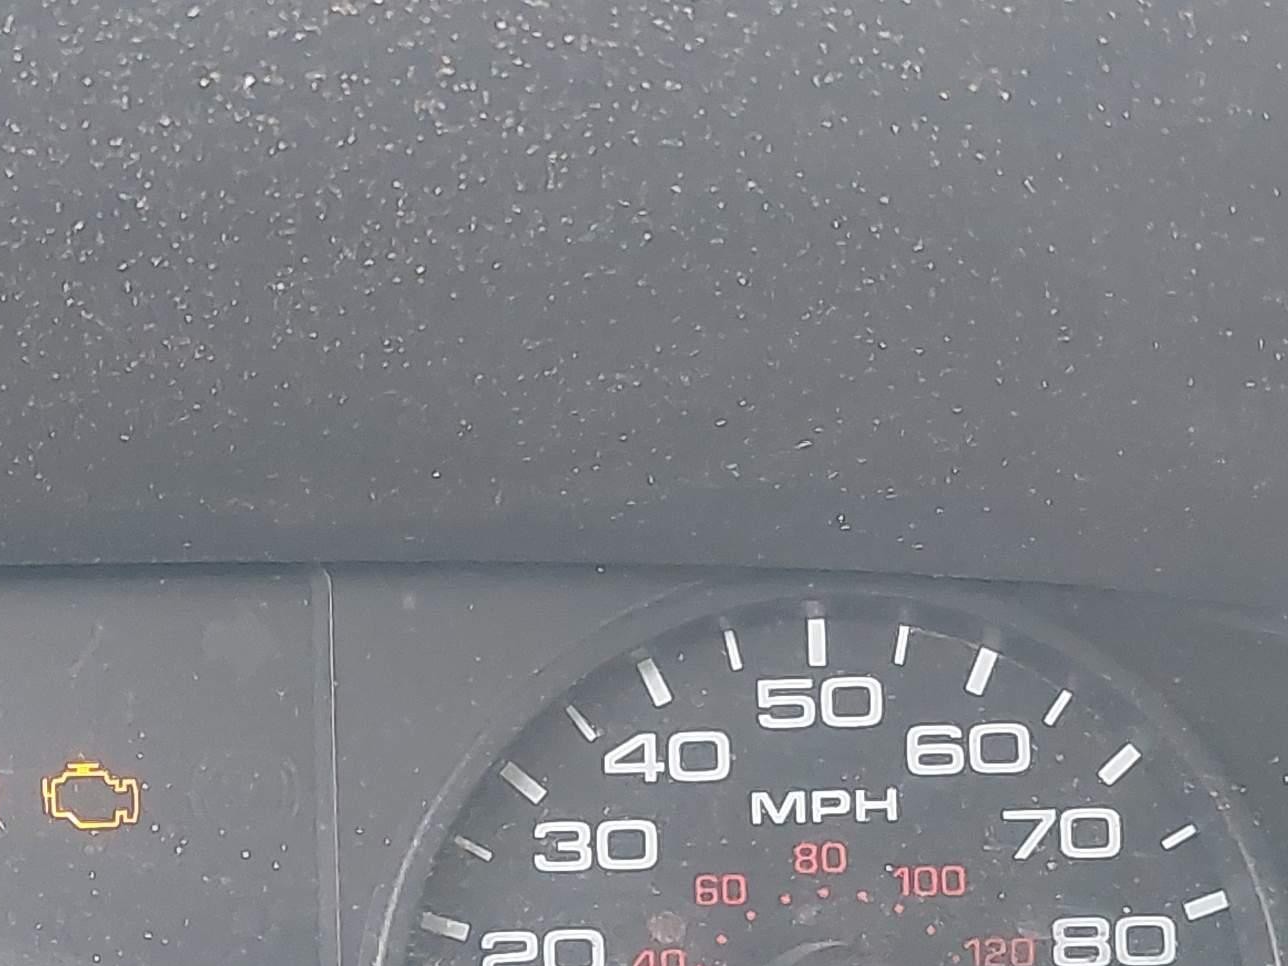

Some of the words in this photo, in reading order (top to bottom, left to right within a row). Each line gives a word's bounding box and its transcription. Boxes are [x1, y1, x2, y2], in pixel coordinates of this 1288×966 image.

[757, 677, 883, 729] 50
[604, 731, 730, 782] 40
[906, 723, 1032, 776] 60
[751, 788, 898, 824] MPH
[534, 820, 658, 871] 30
[794, 841, 847, 874] 80
[1002, 807, 1121, 860] 70
[695, 874, 748, 905] 60
[893, 865, 966, 896] 100
